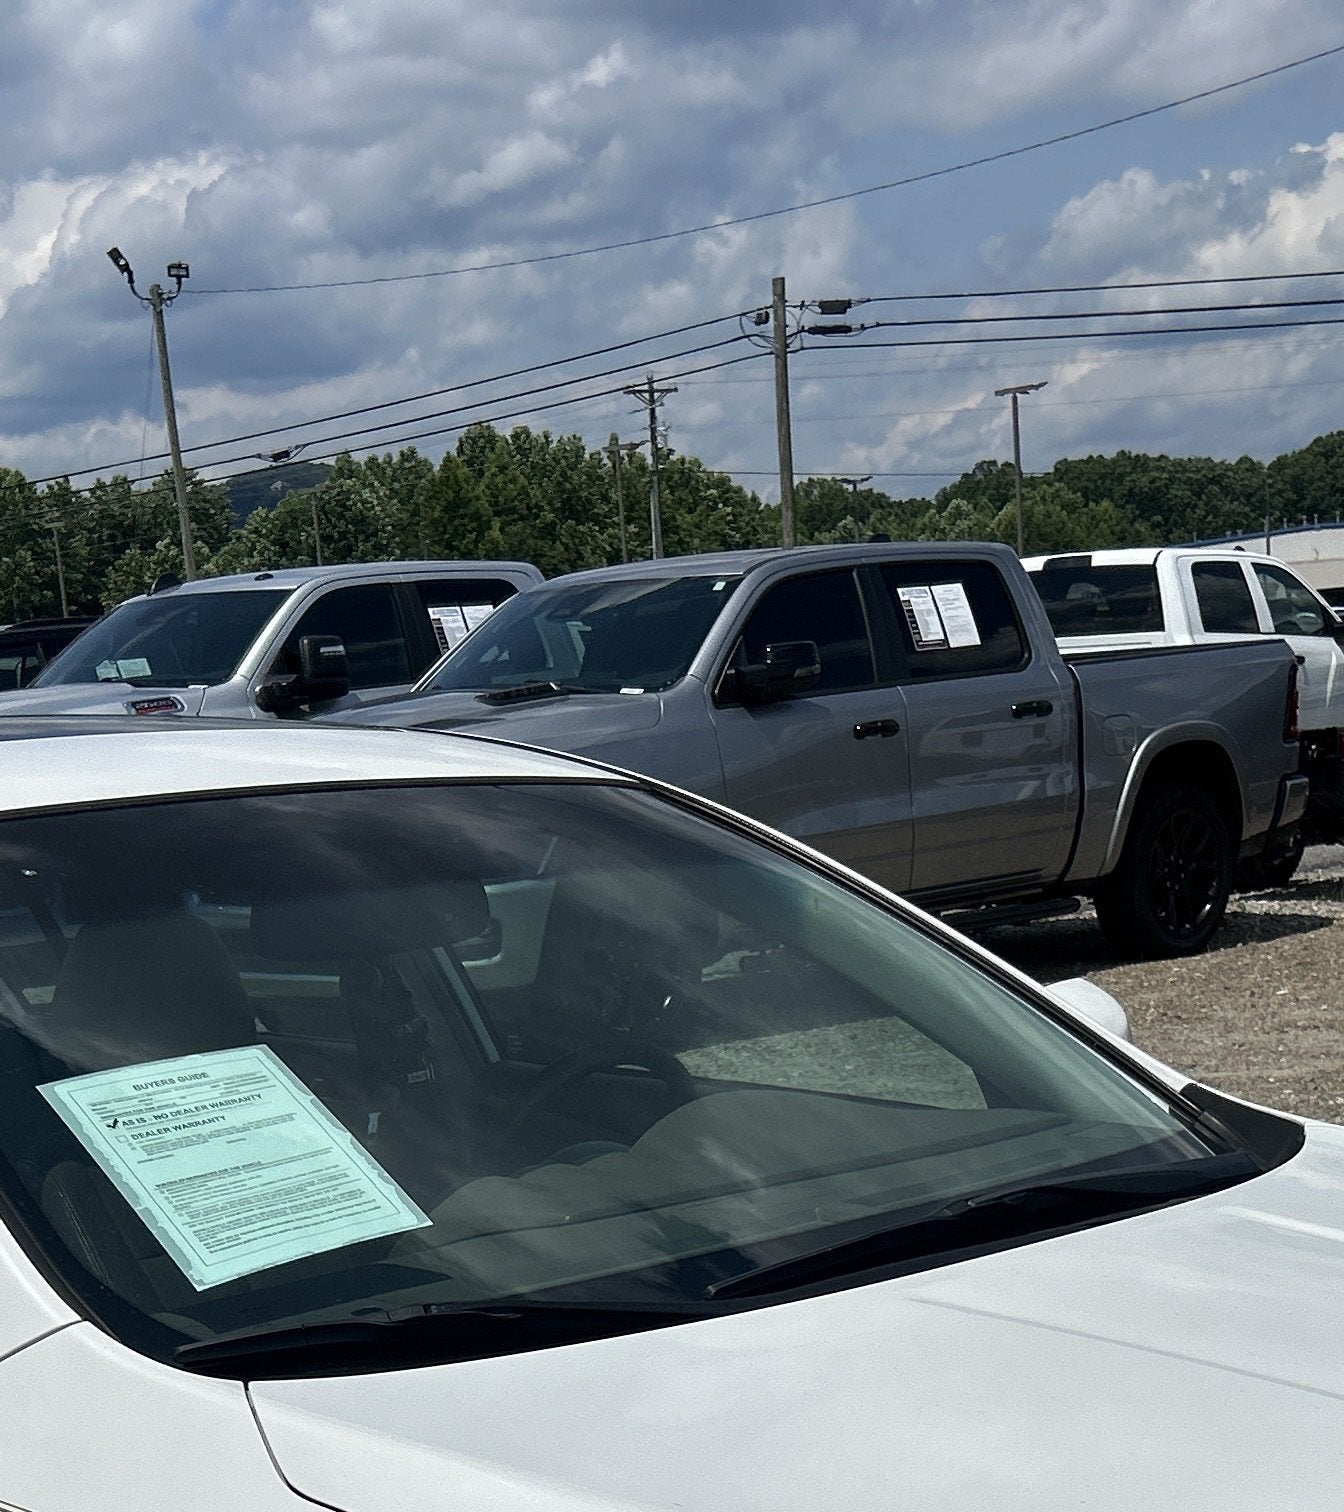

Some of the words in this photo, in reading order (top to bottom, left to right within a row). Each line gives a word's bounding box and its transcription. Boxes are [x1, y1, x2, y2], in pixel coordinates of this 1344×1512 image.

[132, 1078, 176, 1091] BUYERS
[177, 1072, 209, 1084] GUIDE
[122, 1118, 135, 1127] AS
[136, 1117, 147, 1125] IS
[152, 1112, 169, 1121] NO
[170, 1104, 208, 1118] DEALER
[209, 1093, 263, 1110] WARRANTY
[131, 1126, 172, 1141] DEALER
[171, 1115, 227, 1132] WARRANTY
